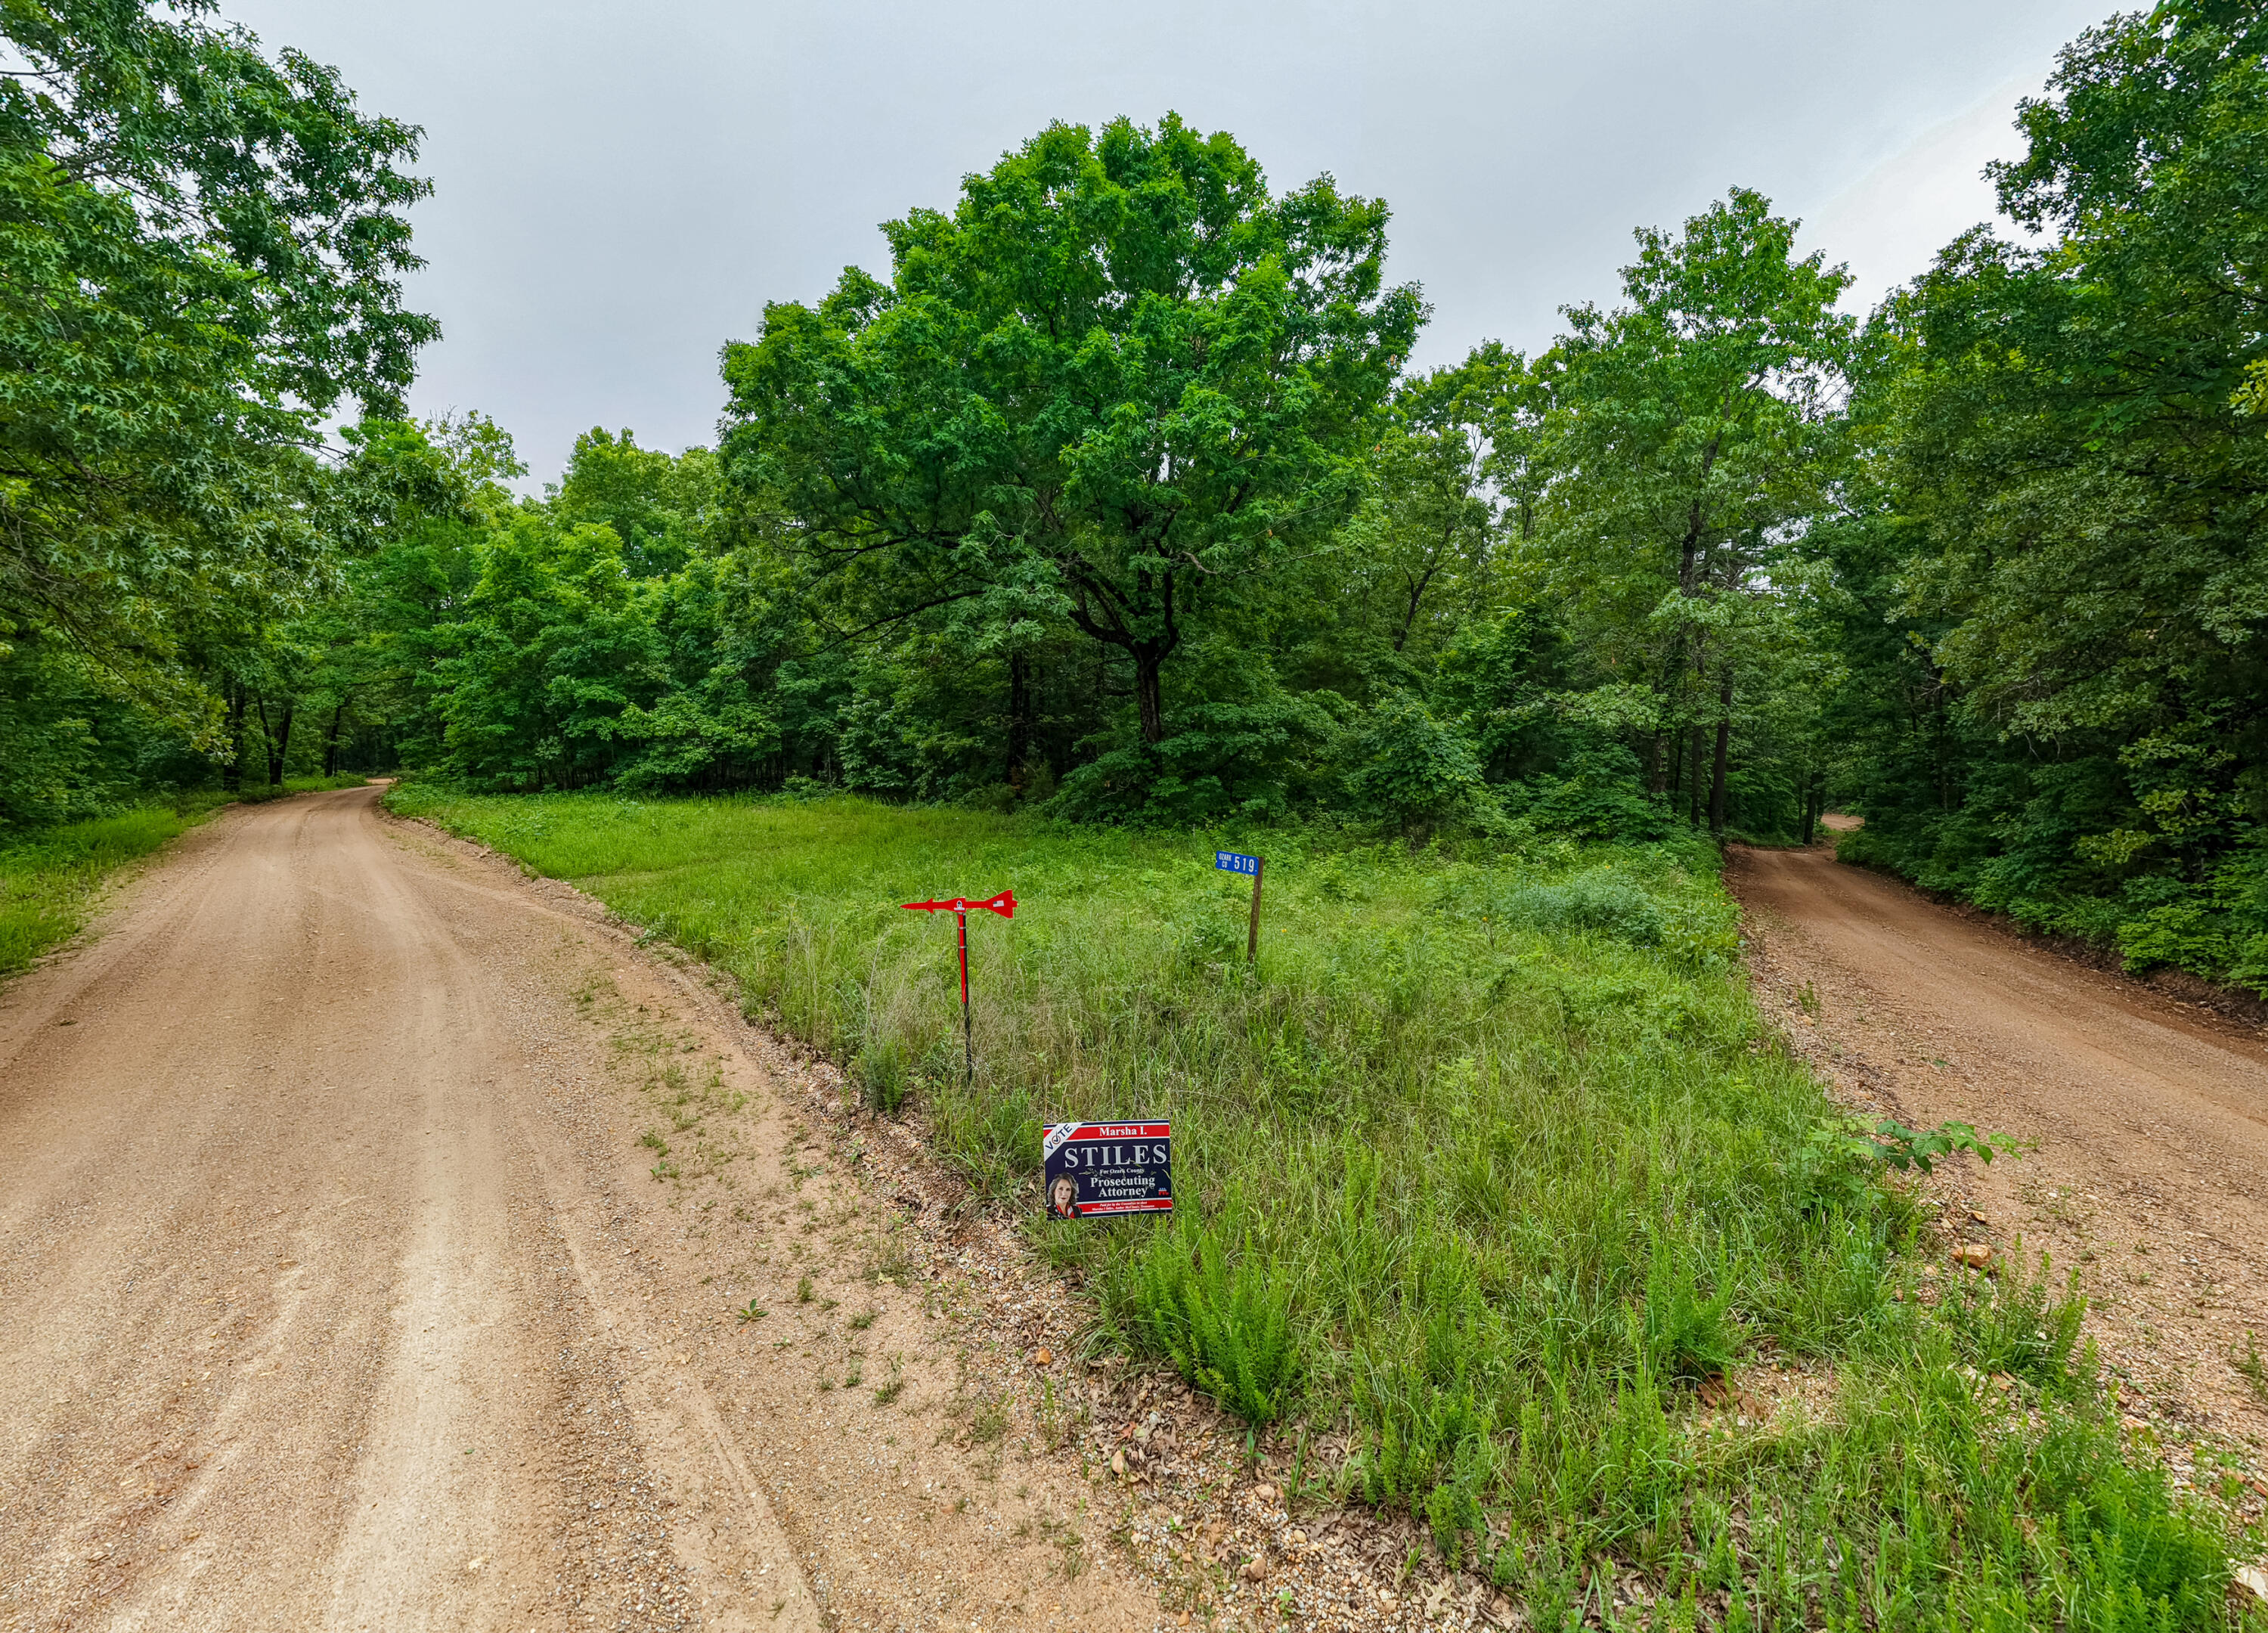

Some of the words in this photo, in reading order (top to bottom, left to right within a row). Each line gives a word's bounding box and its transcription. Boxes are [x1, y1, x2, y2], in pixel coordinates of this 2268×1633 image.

[1219, 853, 1232, 861] OZARK
[1234, 856, 1254, 872] 519
[1045, 1123, 1073, 1150] VOTE
[1099, 1126, 1137, 1137] Marsha
[1139, 1126, 1148, 1135] I.
[1064, 1144, 1167, 1168] STILES
[1090, 1175, 1156, 1188] Prosecuting
[1098, 1186, 1148, 1198] Attorney
